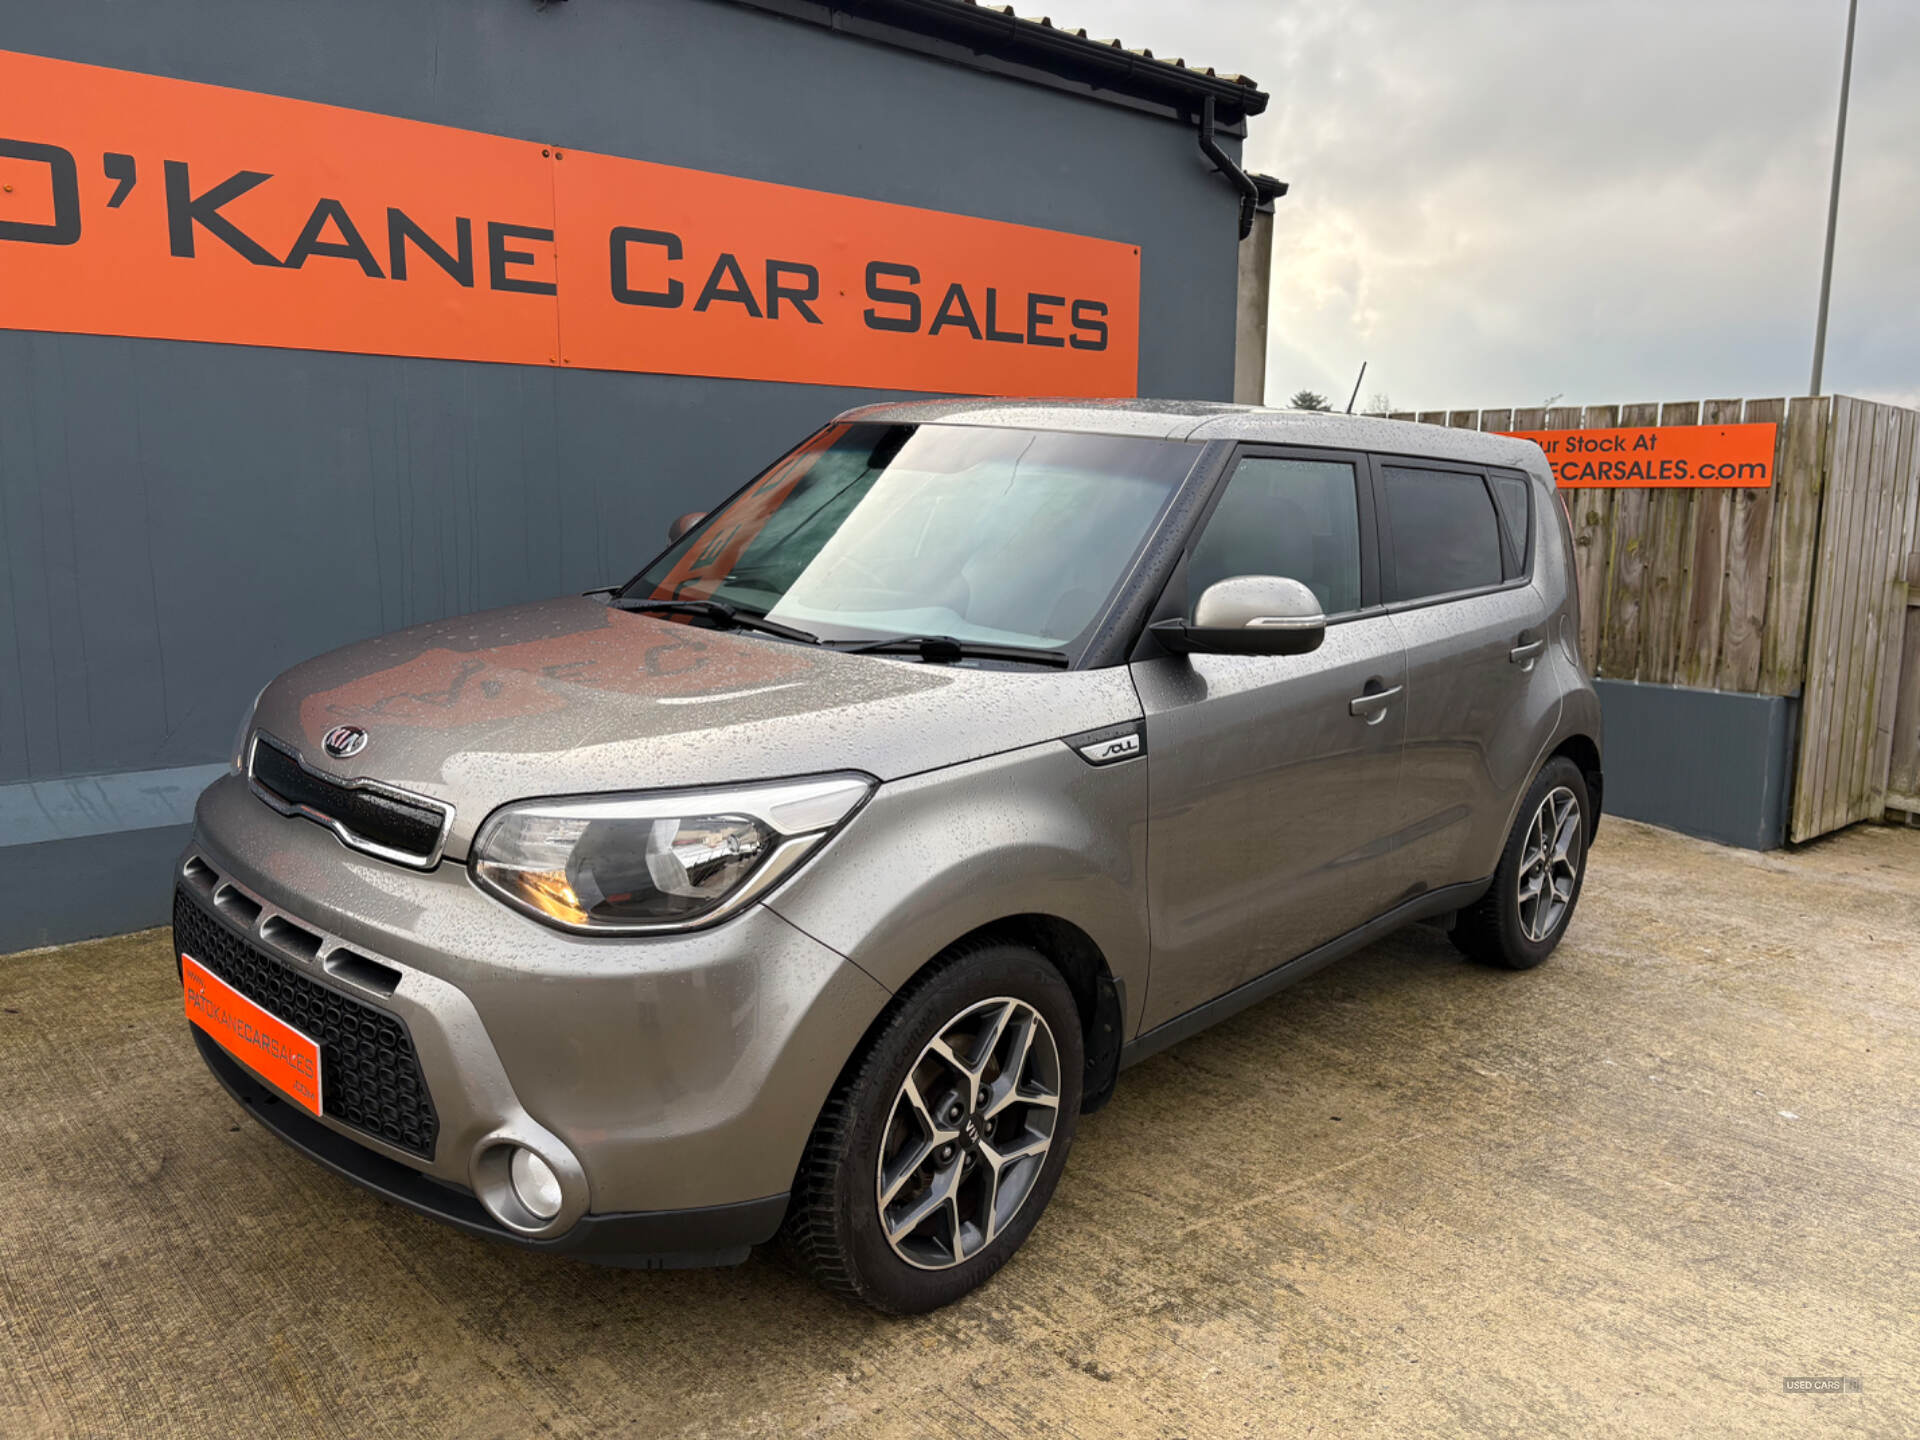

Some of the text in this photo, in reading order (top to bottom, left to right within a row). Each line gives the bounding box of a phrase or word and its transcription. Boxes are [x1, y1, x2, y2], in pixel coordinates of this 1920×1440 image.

[609, 226, 824, 324] CAR
[863, 260, 1109, 351] SALES
[1527, 433, 1658, 454] ur Stock At
[326, 729, 360, 752] KIA
